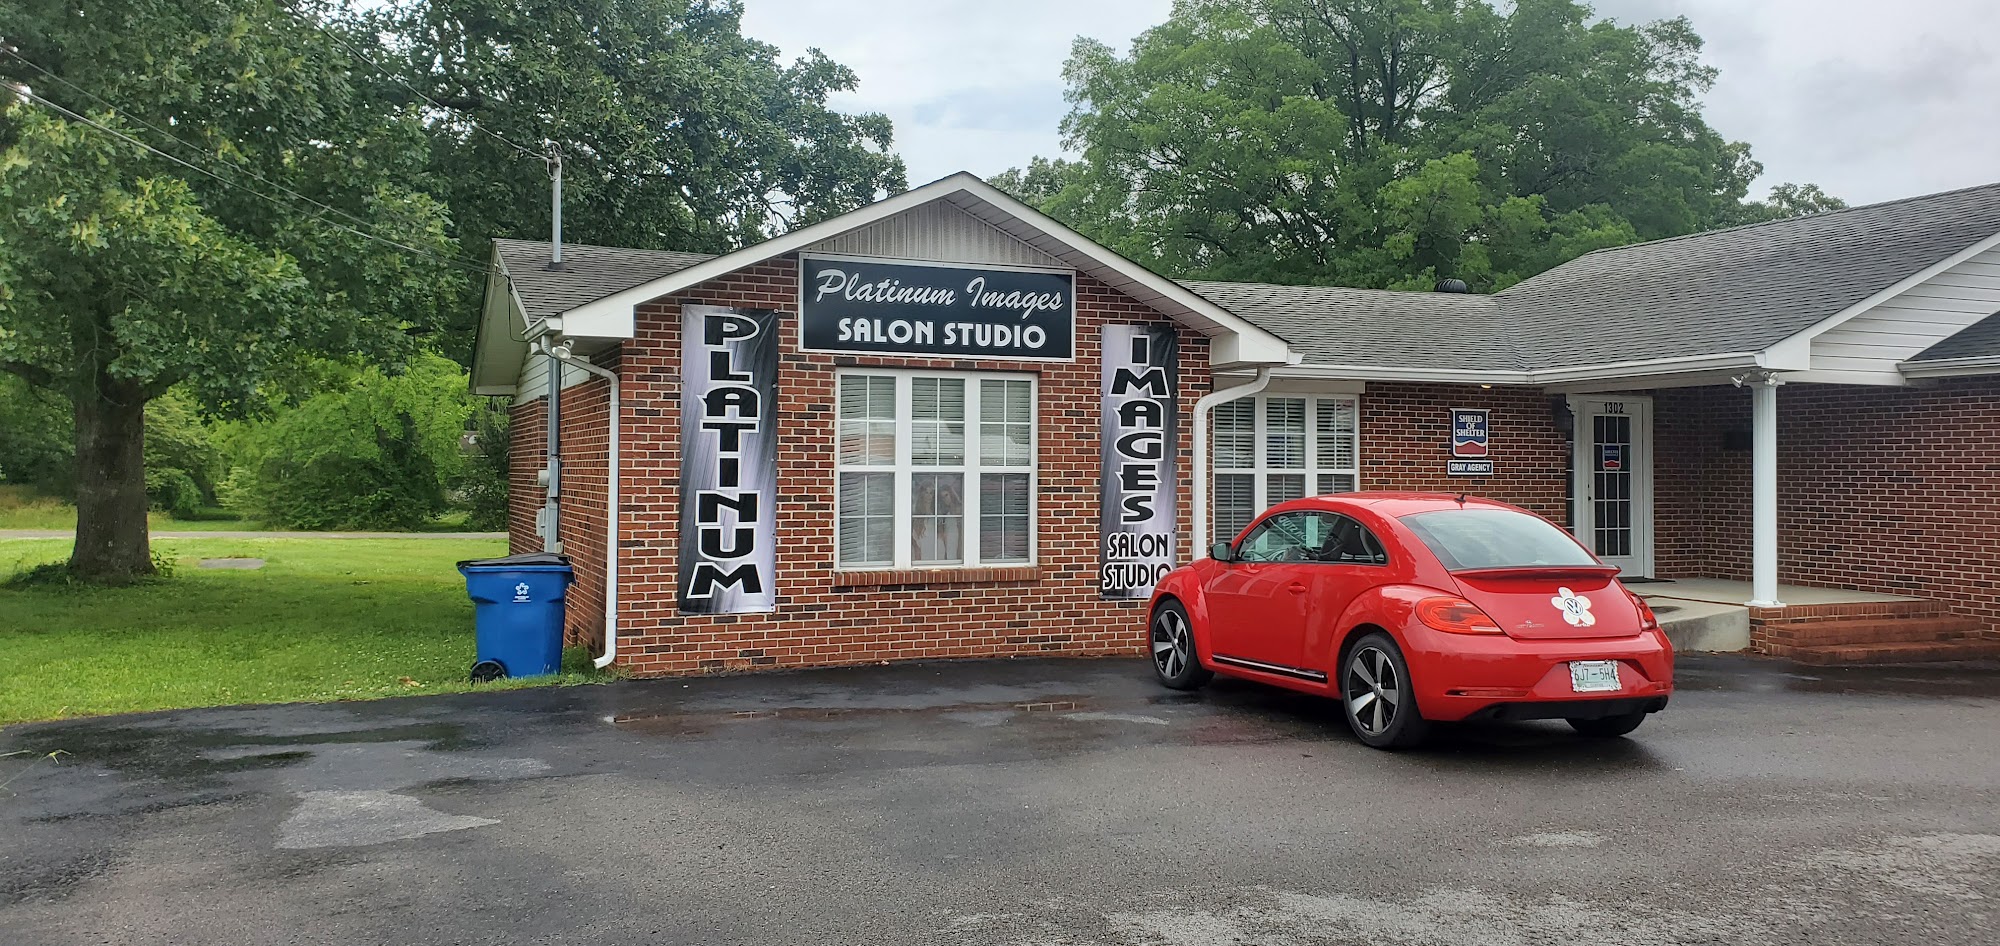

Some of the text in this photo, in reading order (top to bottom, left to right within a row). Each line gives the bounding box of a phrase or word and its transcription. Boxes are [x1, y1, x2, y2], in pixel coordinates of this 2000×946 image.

[816, 268, 1064, 319] Platinum Images
[838, 317, 1046, 349] SALON STUDIO
[1604, 401, 1624, 414] 1302
[1458, 414, 1483, 423] SHIELD
[1465, 422, 1476, 430] OF
[1107, 334, 1171, 525] IMAGES
[1456, 428, 1485, 437] SHELTER
[686, 313, 763, 599] PLATINUM
[1450, 463, 1491, 472] GRAY AGENCY
[1106, 531, 1169, 560] SALON
